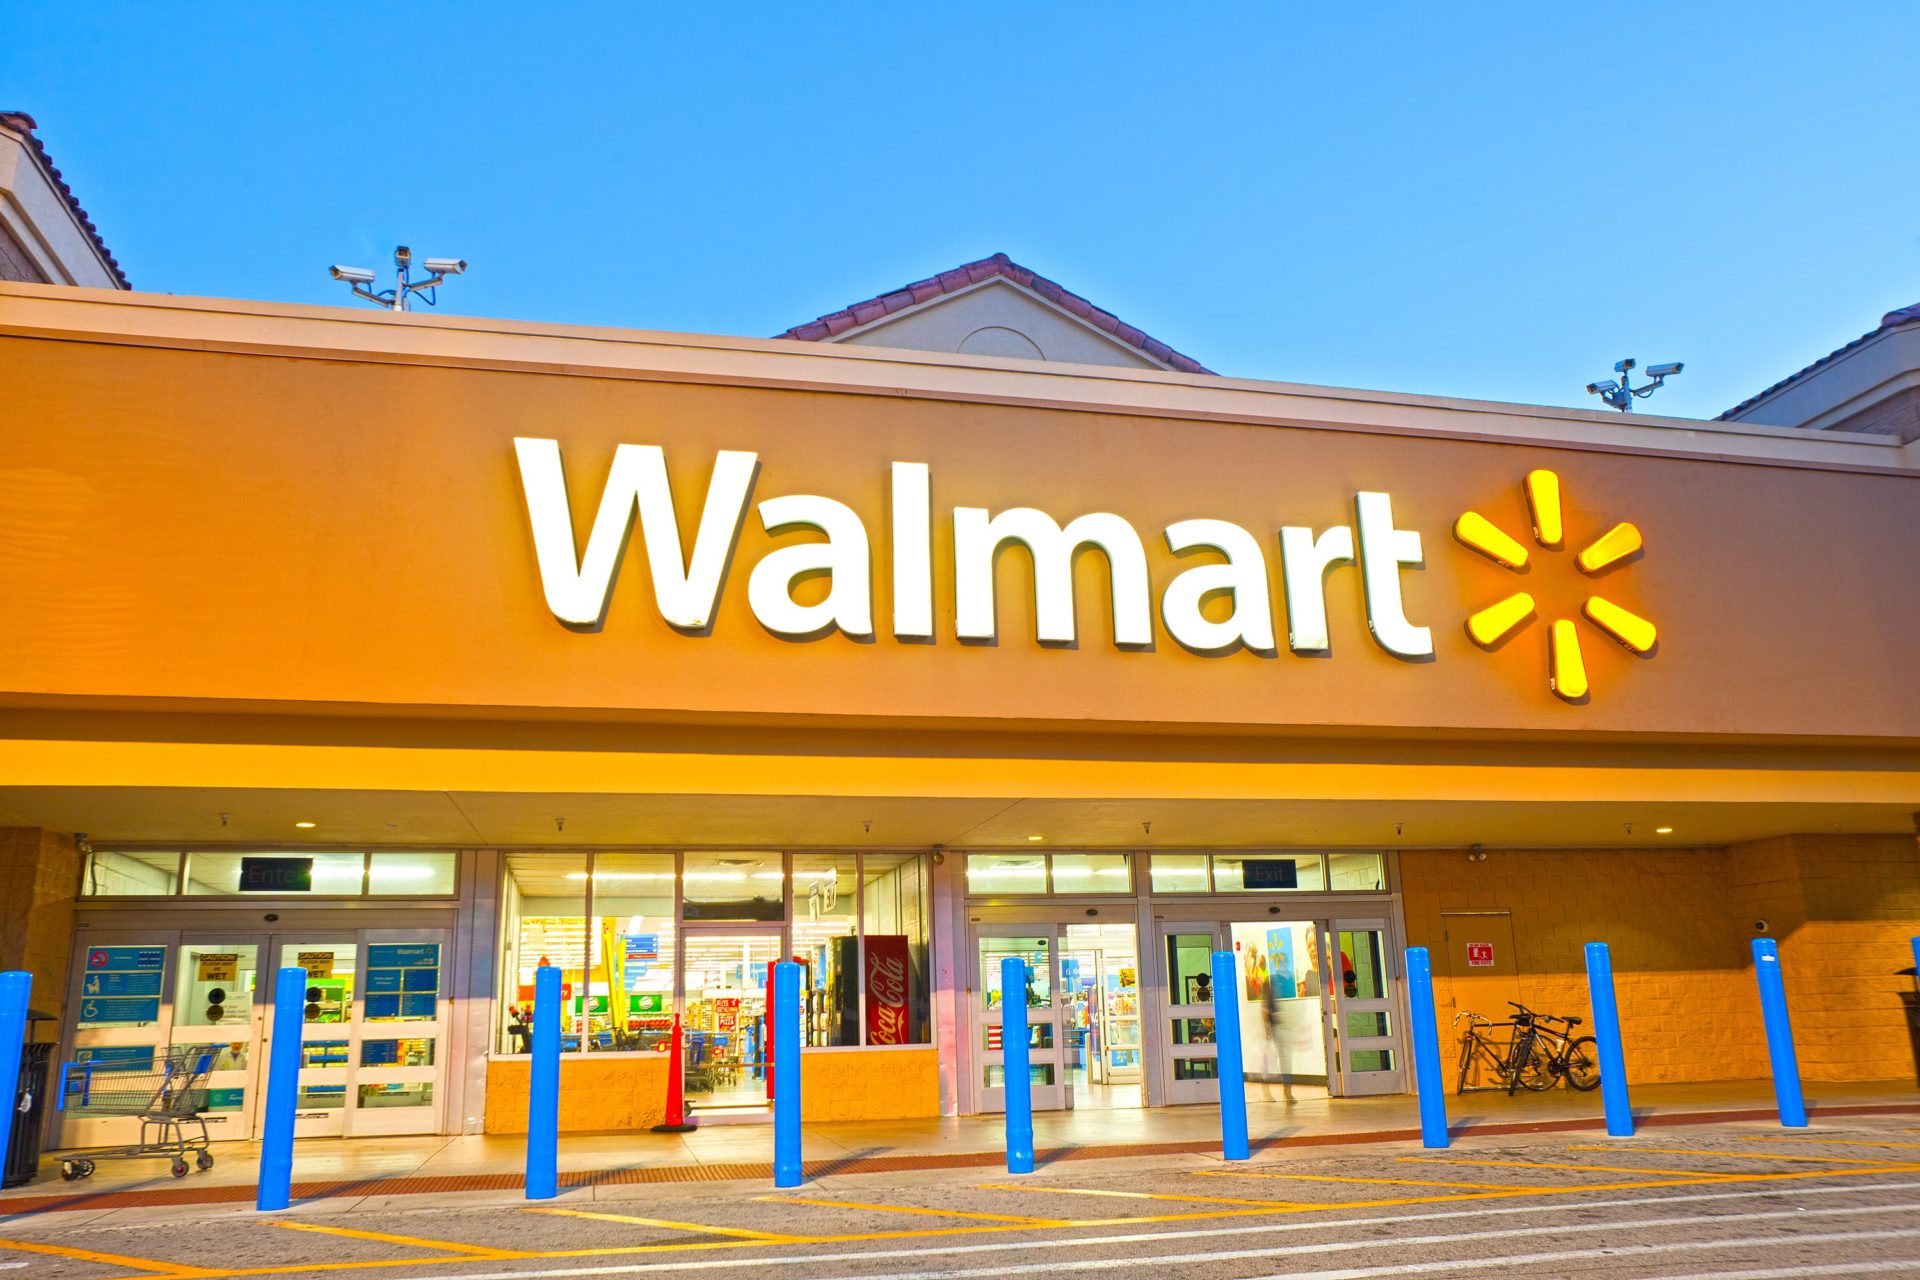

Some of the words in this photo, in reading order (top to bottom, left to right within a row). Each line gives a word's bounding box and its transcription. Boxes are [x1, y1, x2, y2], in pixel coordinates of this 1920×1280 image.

[513, 436, 1433, 656] Walmart
[1255, 865, 1285, 882] Exit
[206, 972, 228, 980] WET
